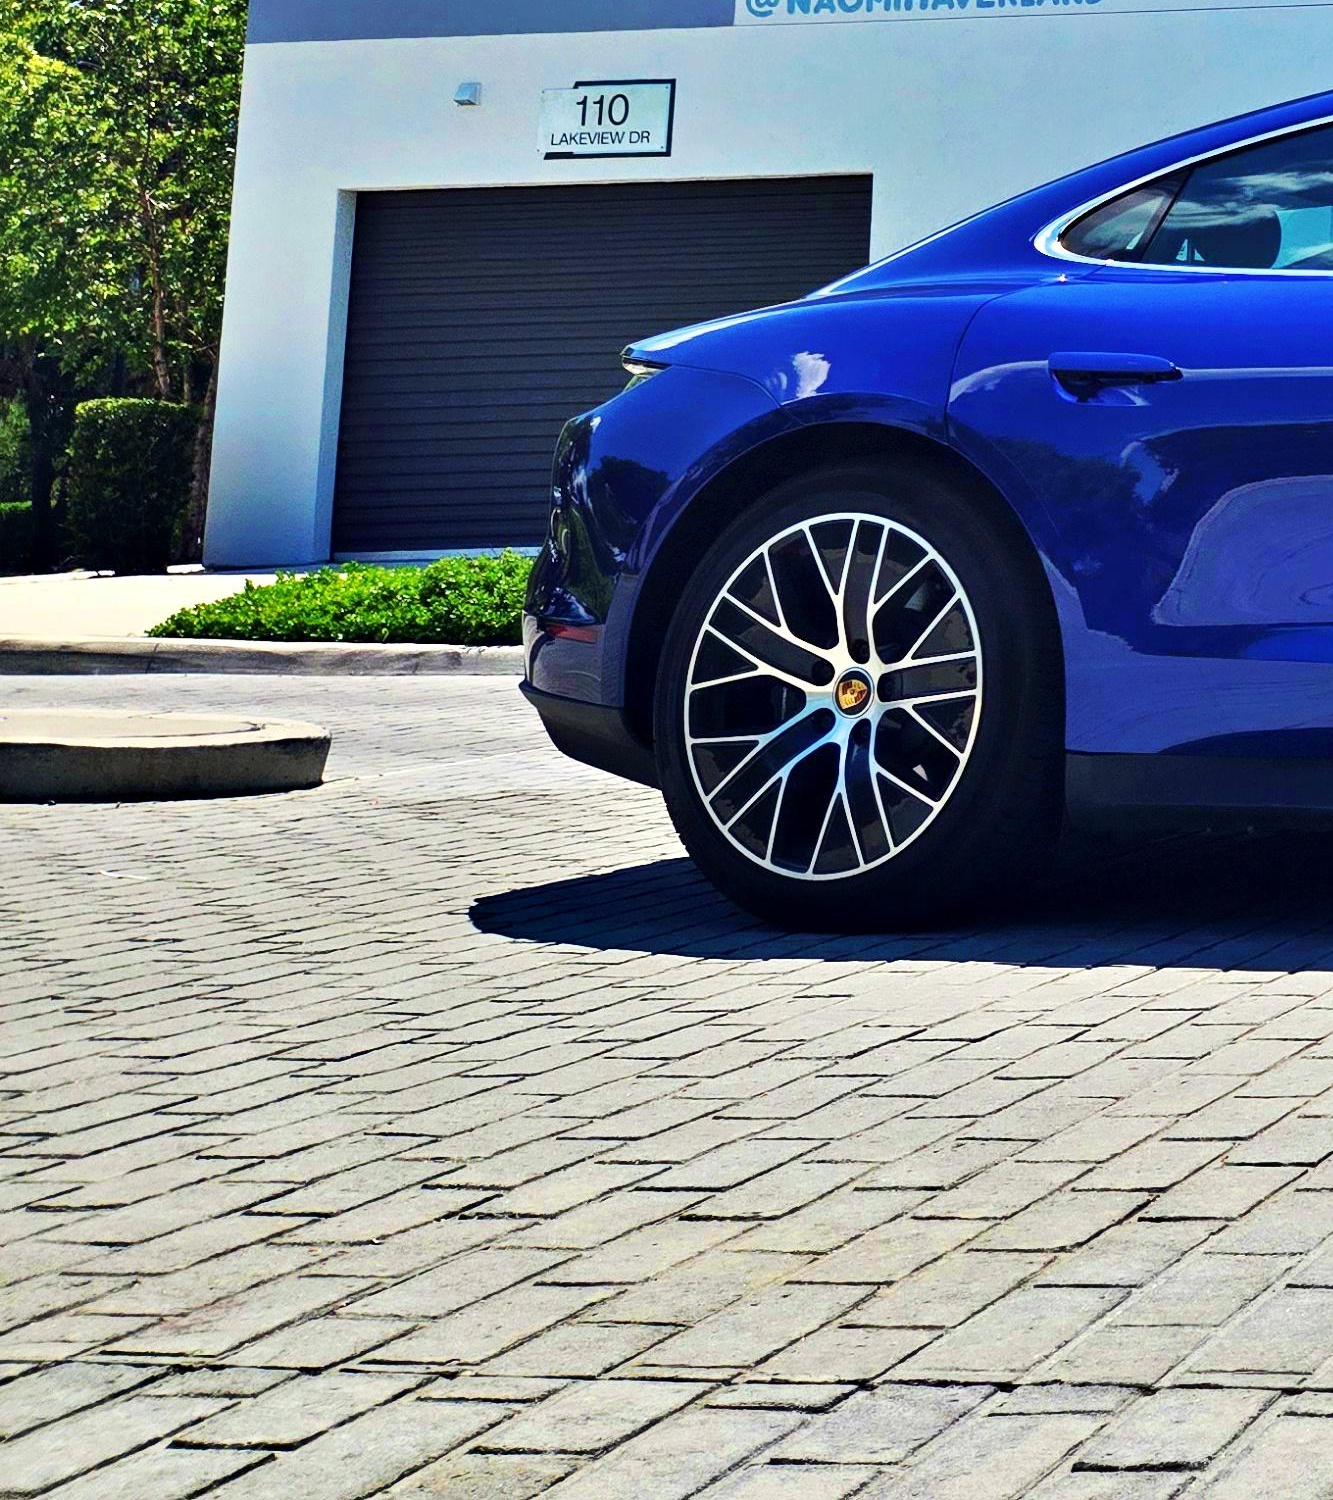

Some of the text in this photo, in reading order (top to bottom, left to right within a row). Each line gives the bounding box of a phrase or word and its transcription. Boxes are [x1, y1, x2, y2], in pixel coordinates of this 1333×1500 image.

[576, 94, 630, 127] 110
[550, 131, 651, 146] LAKEVIEW DR
